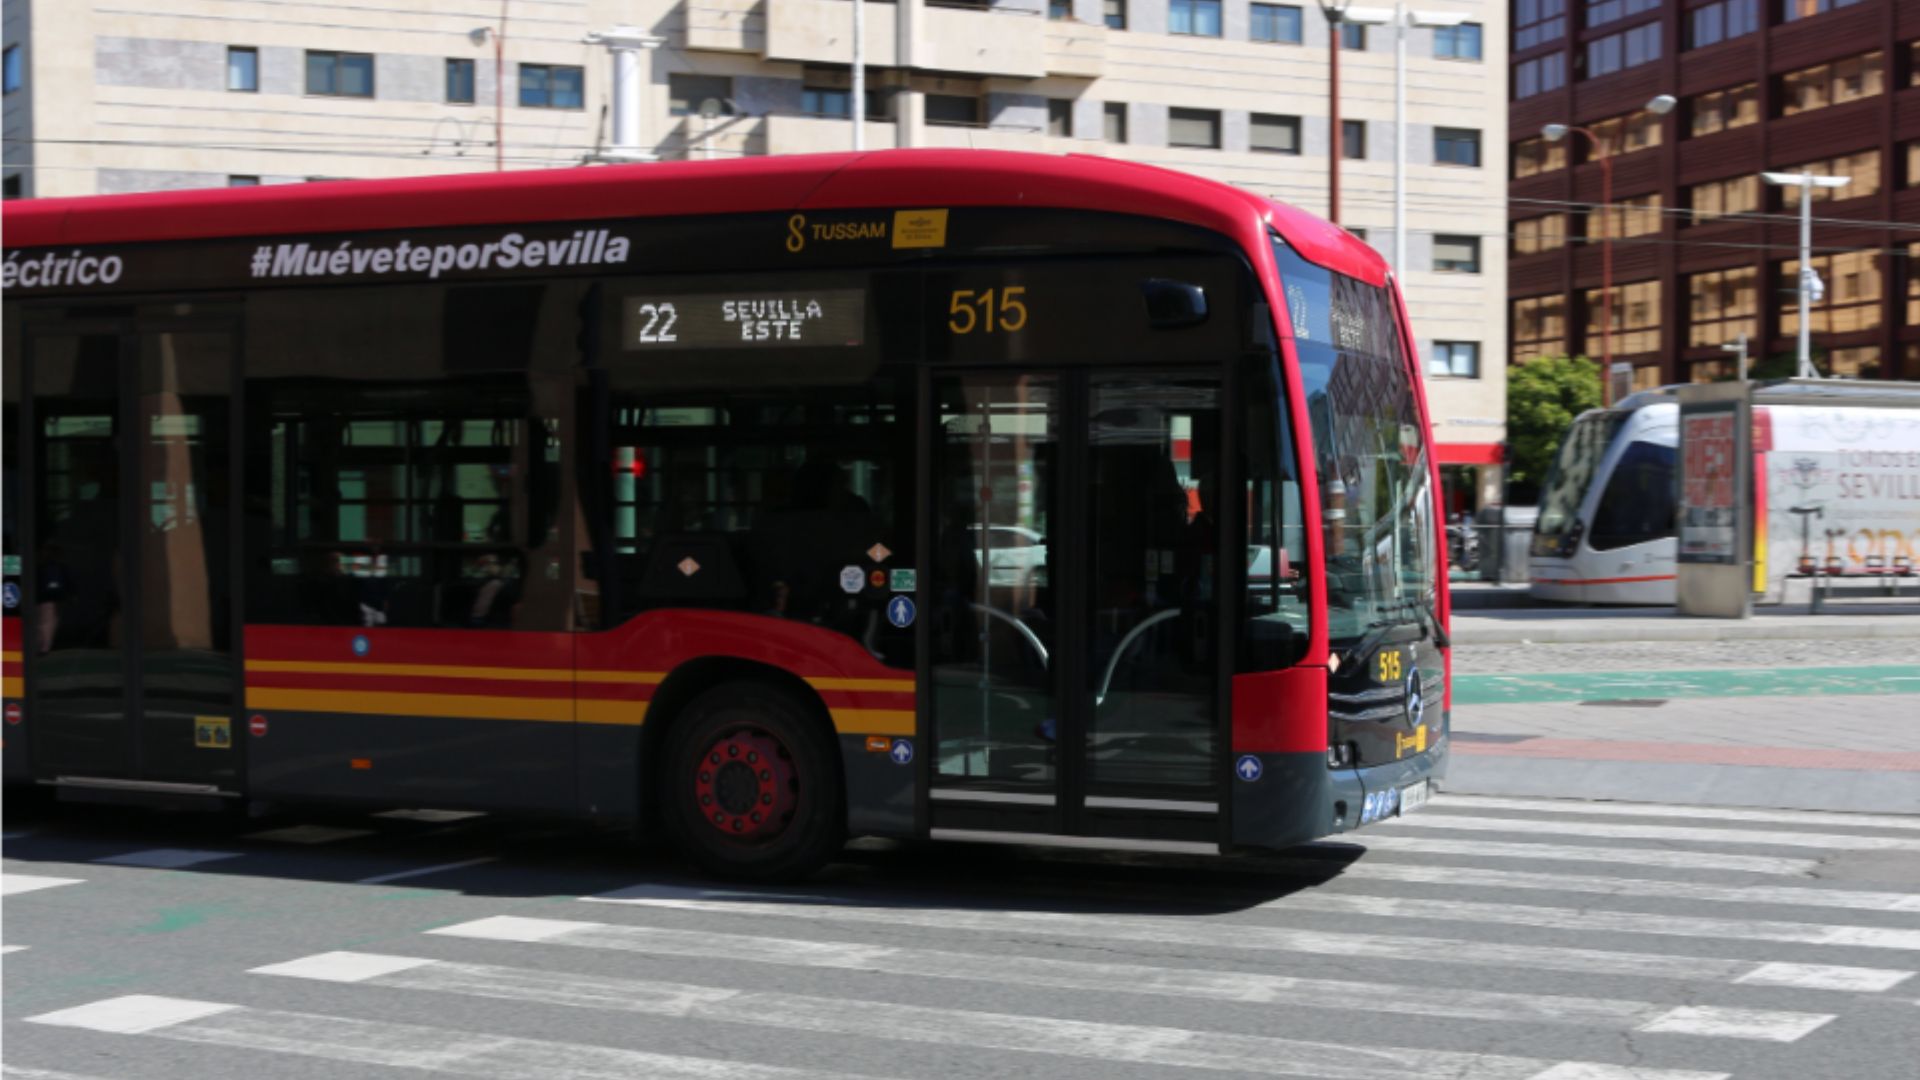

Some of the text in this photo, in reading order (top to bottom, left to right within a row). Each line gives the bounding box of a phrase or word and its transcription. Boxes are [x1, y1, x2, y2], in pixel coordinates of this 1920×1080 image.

[812, 222, 887, 241] TUSSAM
[2, 250, 123, 288] éctrico
[251, 230, 630, 279] #MuéveteporSevilla
[639, 302, 678, 343] 22
[722, 300, 822, 321] SEVILLA
[949, 286, 1027, 334] 515
[741, 321, 803, 341] ESTE
[1379, 651, 1400, 681] 515
